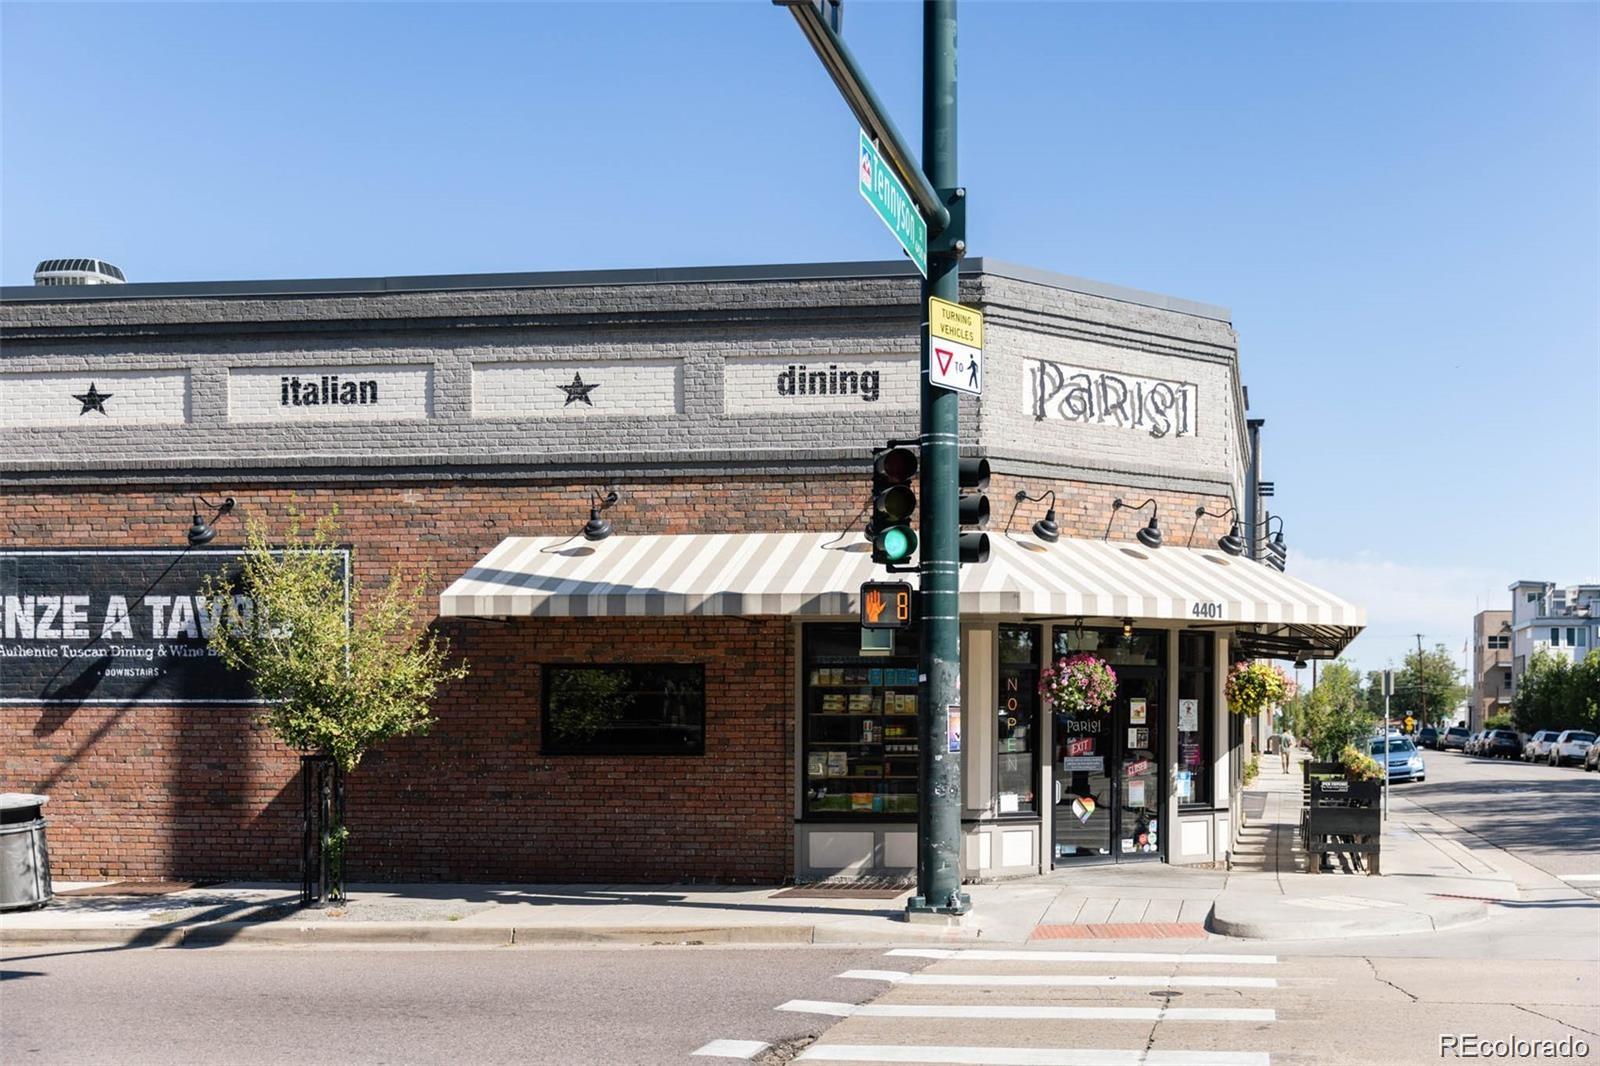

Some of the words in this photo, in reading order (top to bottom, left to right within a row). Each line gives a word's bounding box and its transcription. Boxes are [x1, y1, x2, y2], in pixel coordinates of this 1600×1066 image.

[873, 154, 915, 245] Tennyson
[941, 308, 972, 327] TURNING
[940, 323, 974, 342] VEHICLES
[955, 361, 964, 374] TO
[280, 375, 378, 406] italian
[777, 365, 880, 401] dining
[897, 592, 908, 620] 8
[1192, 602, 1222, 618] 4401
[0, 595, 91, 639] NZE
[101, 595, 134, 639] A
[0, 644, 59, 657] Authentic
[60, 644, 107, 658] Tuscan
[109, 644, 154, 661] Dining
[157, 643, 168, 657] &
[169, 644, 204, 657] Wine
[105, 668, 160, 677] DOWNSTAIRS
[1071, 739, 1090, 754] EXIT
